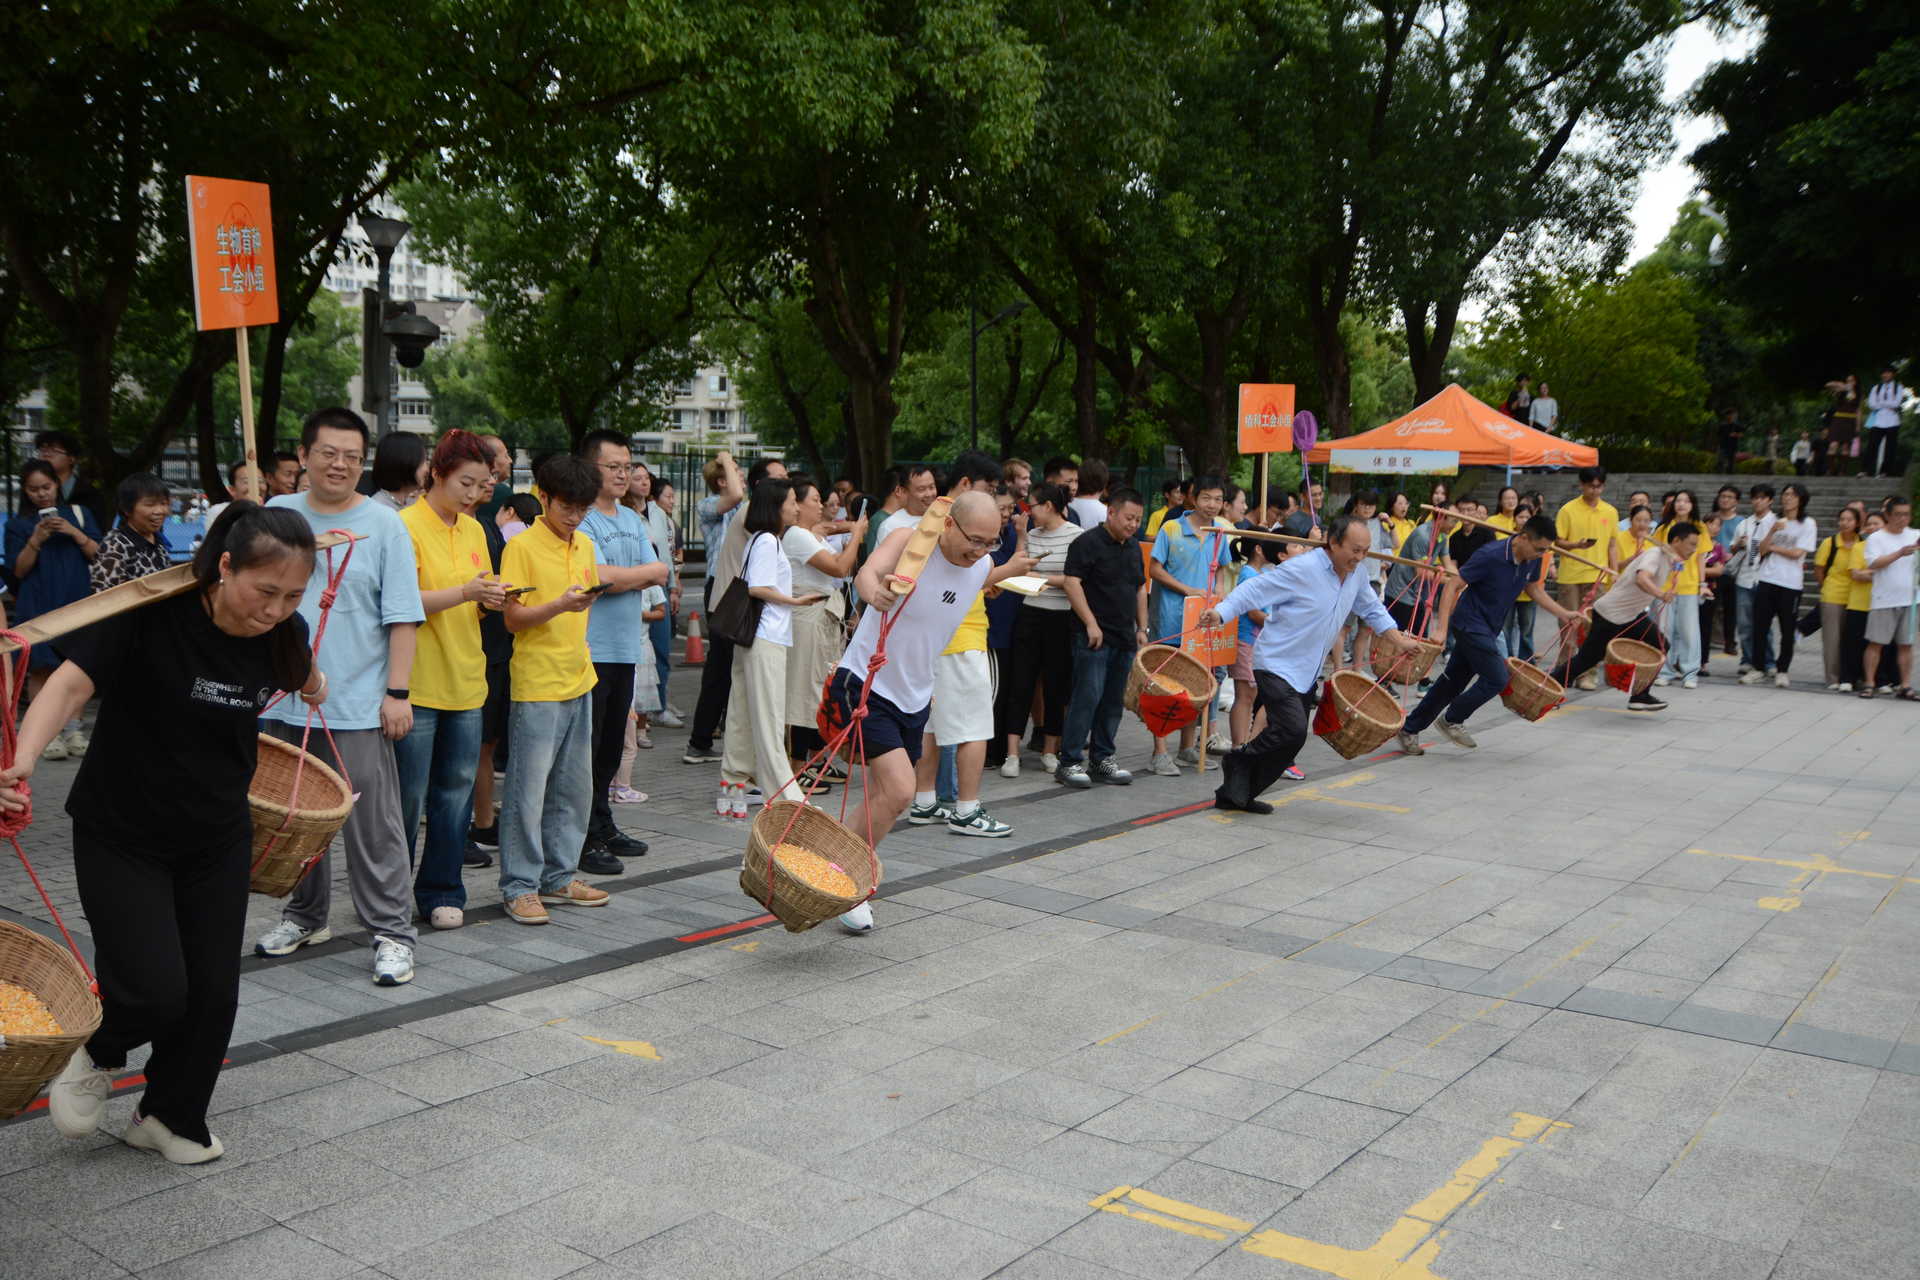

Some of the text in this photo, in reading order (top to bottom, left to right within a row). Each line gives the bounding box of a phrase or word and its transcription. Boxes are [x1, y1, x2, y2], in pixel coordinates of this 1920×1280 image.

[219, 263, 265, 294] 工会小组
[1373, 456, 1412, 467] 休息区
[203, 686, 218, 695] THE
[191, 691, 253, 707] ORIGINAL ROOM
